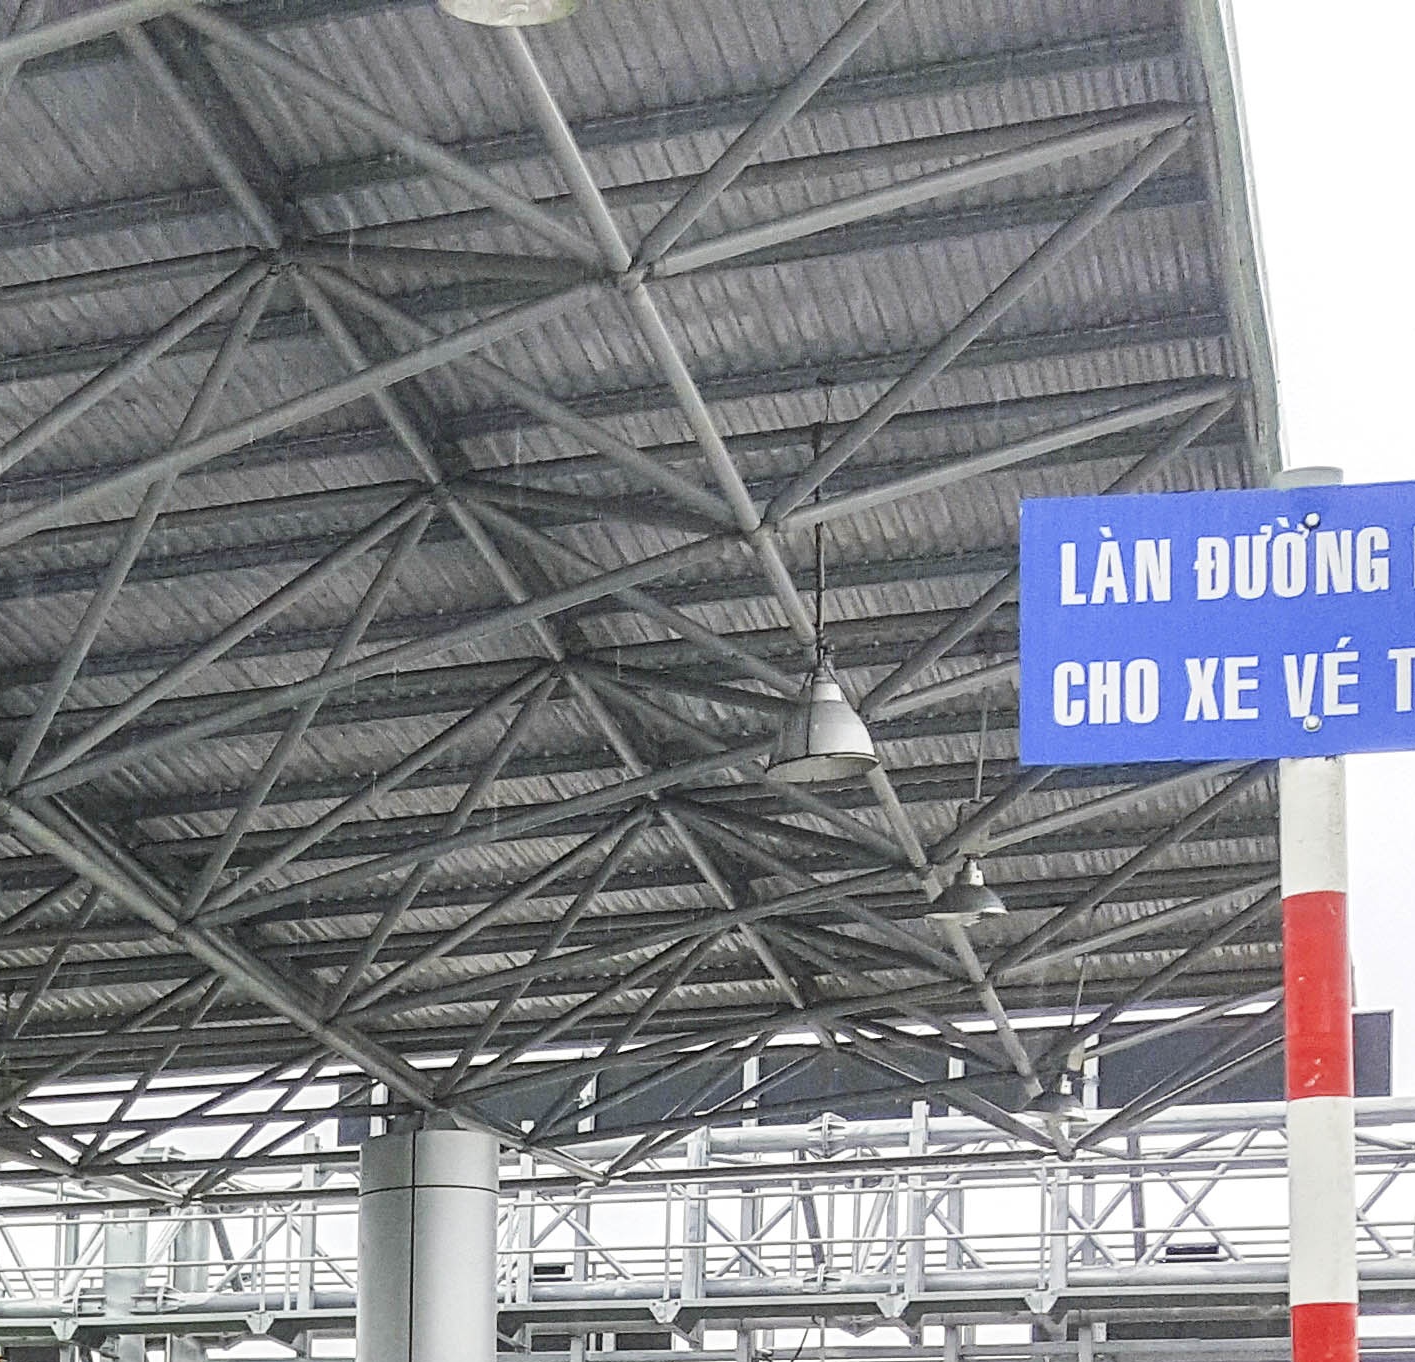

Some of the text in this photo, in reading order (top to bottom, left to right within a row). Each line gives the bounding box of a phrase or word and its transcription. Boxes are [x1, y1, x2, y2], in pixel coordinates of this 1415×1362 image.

[1060, 515, 1390, 606] LÀN ĐƯỜNG
[1053, 657, 1160, 727] CHO
[1183, 656, 1260, 721] XE
[1283, 637, 1359, 720] VÉ
